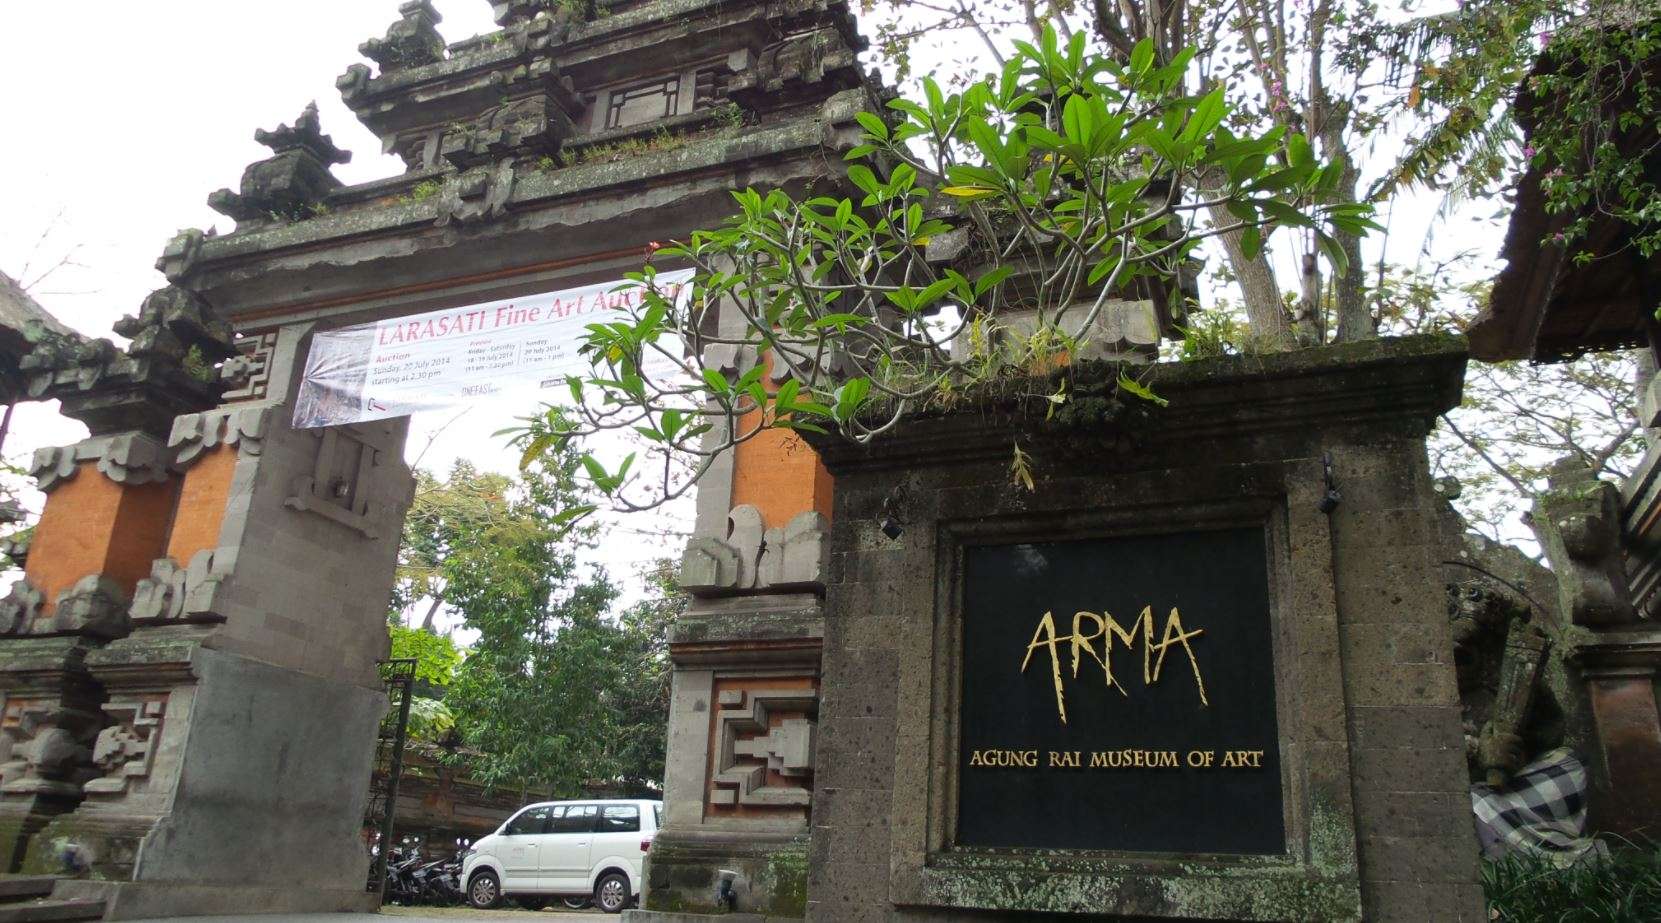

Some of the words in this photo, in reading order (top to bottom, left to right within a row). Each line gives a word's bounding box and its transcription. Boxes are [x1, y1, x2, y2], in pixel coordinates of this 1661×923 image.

[378, 310, 486, 345] LARASATI
[495, 304, 540, 328] Fine
[547, 295, 584, 319] Art
[467, 347, 486, 355] Friday
[534, 347, 545, 355] July
[545, 344, 561, 353] 2014
[376, 353, 410, 364] Auction
[486, 354, 498, 362] July
[498, 351, 514, 360] 2014
[415, 360, 430, 370] July
[431, 357, 451, 367] 2014
[372, 376, 400, 385] starting
[401, 374, 409, 382] at
[410, 371, 427, 380] 2.30
[428, 369, 441, 379] pm
[1020, 604, 1208, 725] ARMA
[969, 749, 1038, 768] AGUNG
[1048, 751, 1081, 768] RAI
[1089, 749, 1179, 768] MUSEUM
[1187, 750, 1215, 768] OF
[1221, 750, 1265, 768] ART
